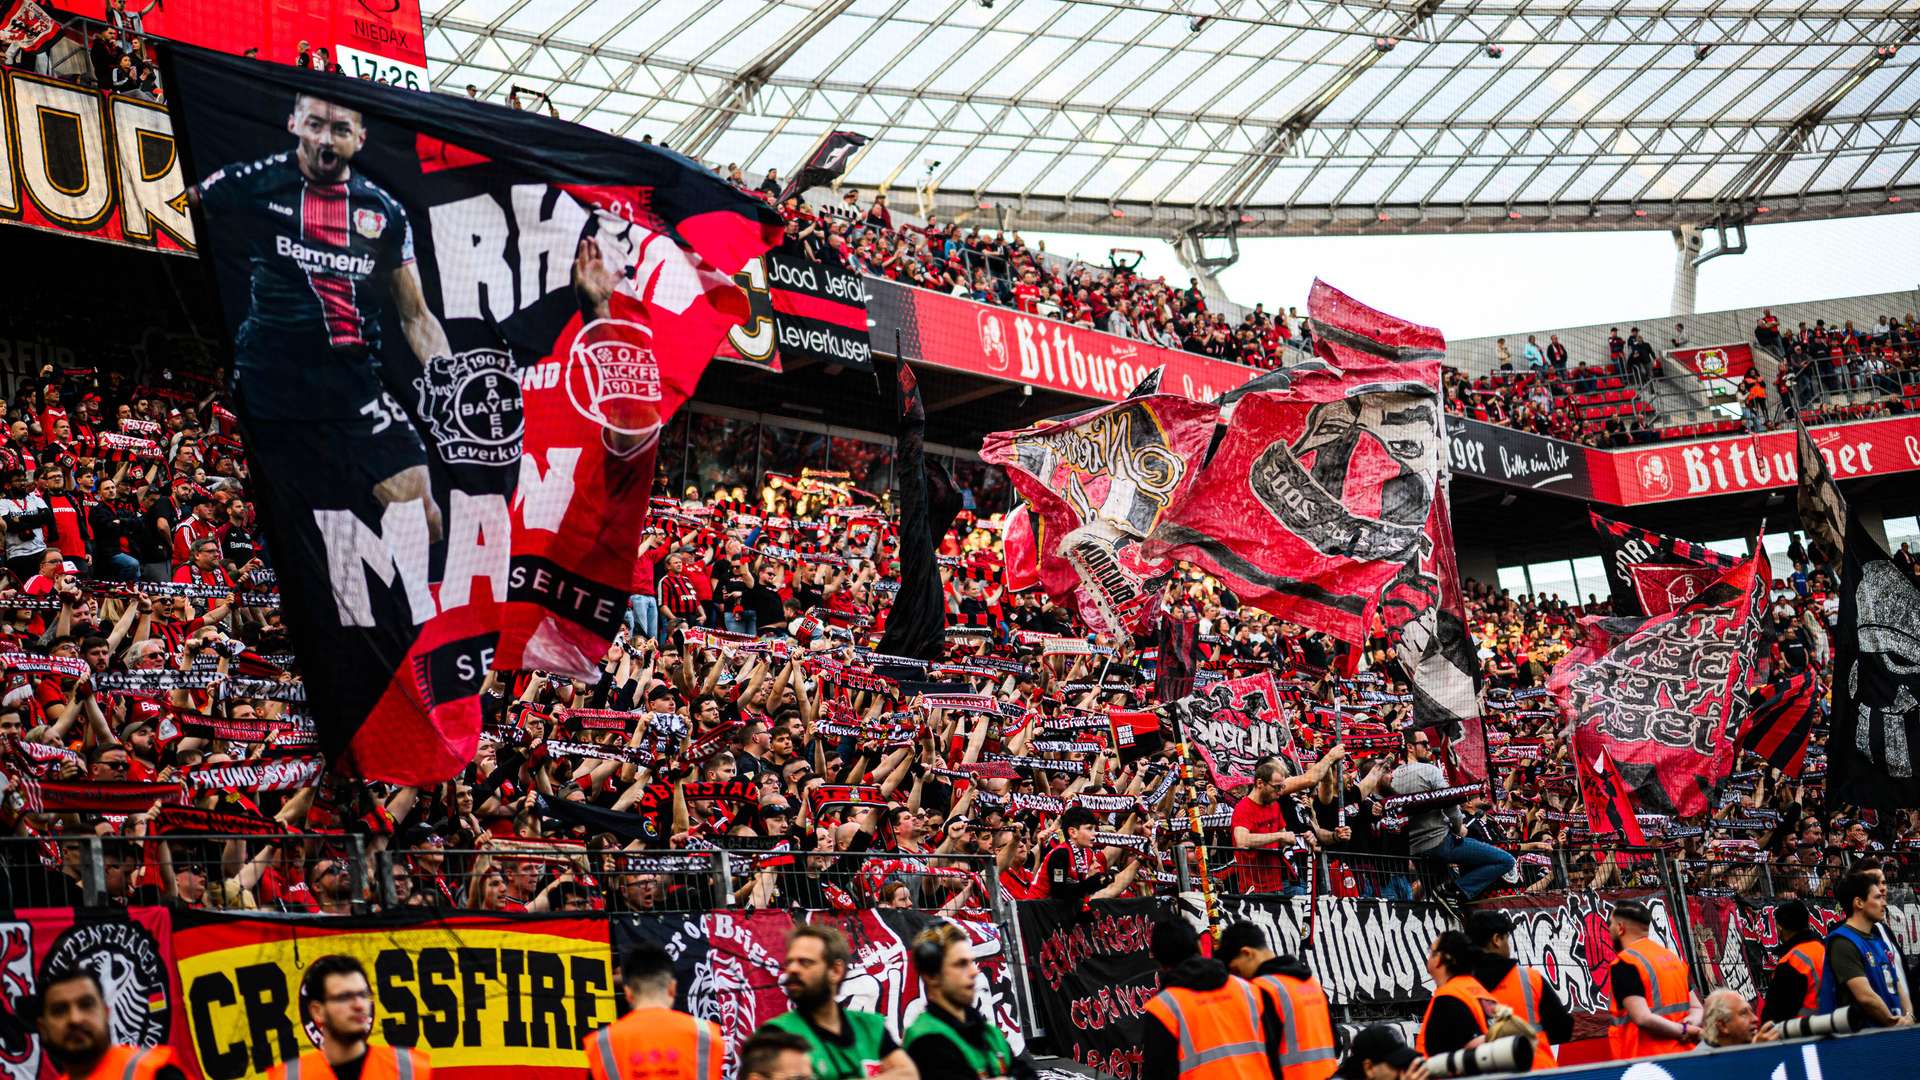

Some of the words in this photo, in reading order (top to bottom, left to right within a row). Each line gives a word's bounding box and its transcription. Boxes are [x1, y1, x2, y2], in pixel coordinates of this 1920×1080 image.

[354, 17, 408, 48] NIEDAX
[352, 55, 420, 91] 17:26
[276, 235, 376, 275] Barmenia
[768, 257, 818, 290] Jood
[776, 318, 872, 362] Leverkusen
[1014, 317, 1152, 399] Bitburge
[509, 566, 615, 623] SEITE
[1044, 718, 1069, 729] ALLES
[189, 765, 257, 792] FREUND
[188, 946, 612, 1080] CRSSFIRE
